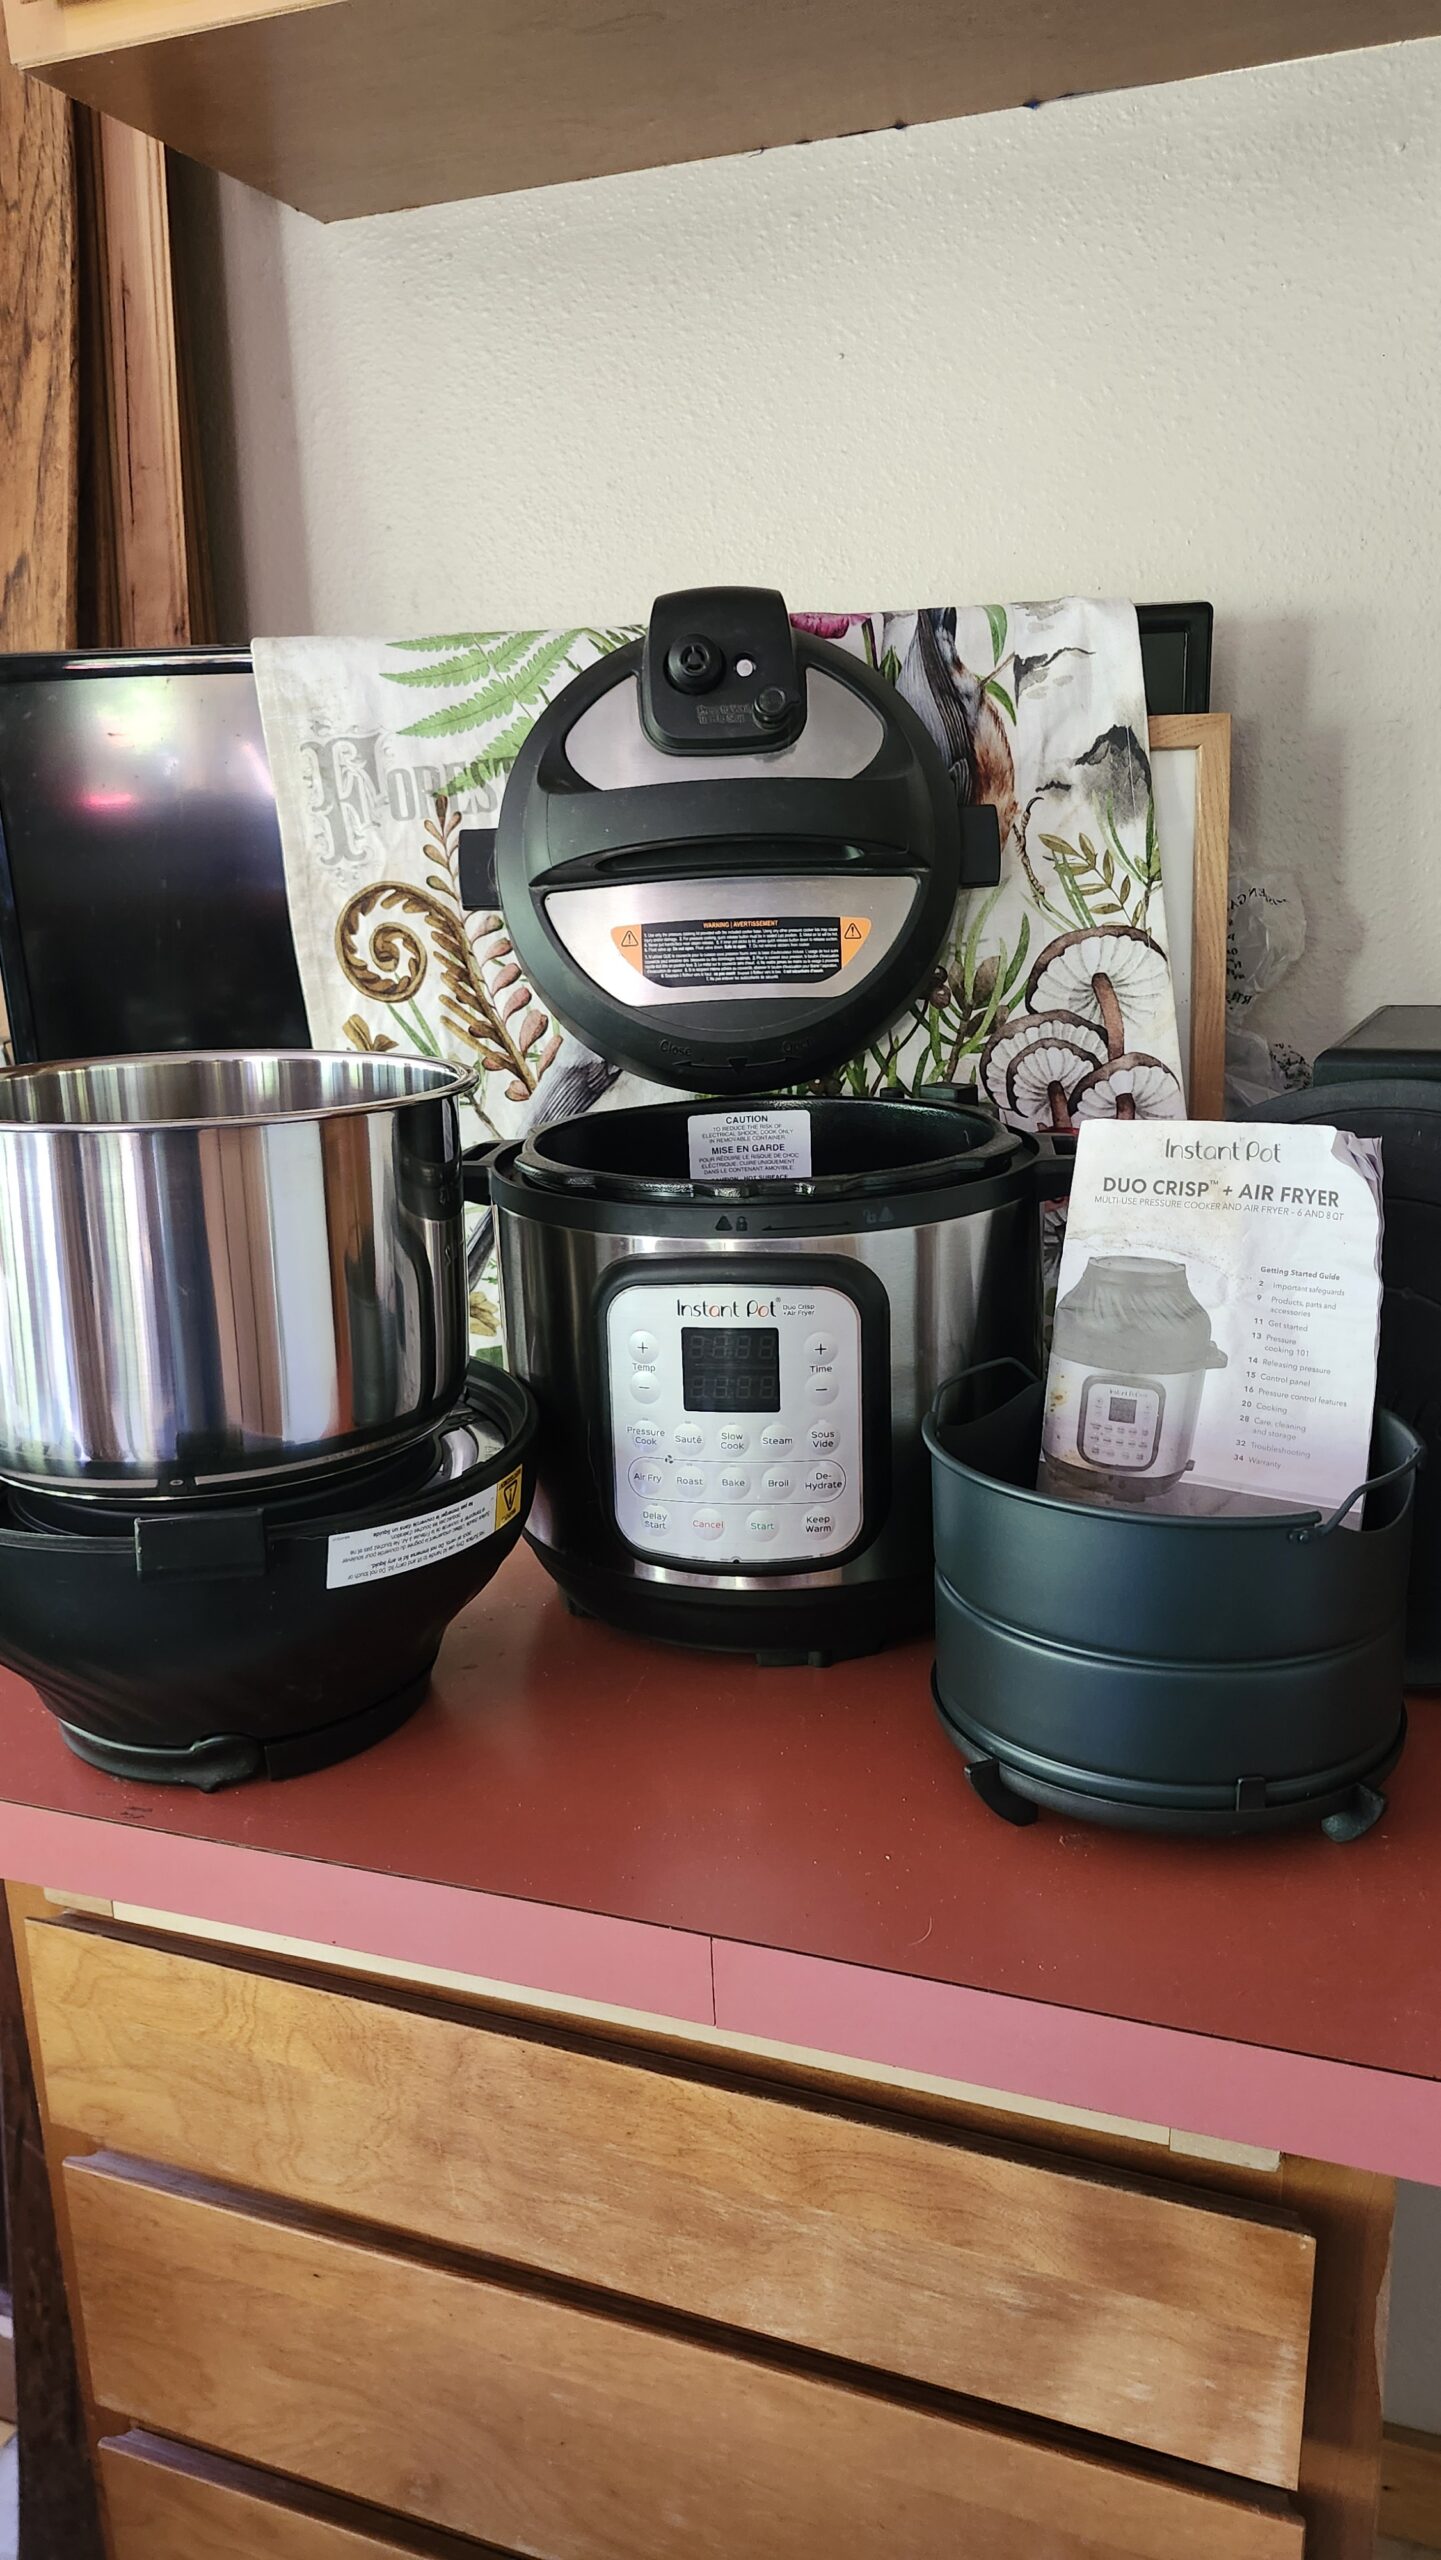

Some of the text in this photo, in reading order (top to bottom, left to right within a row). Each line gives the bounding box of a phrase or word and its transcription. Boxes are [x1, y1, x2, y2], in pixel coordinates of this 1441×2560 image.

[733, 920, 778, 928] AVERTISSEMENT
[658, 1038, 692, 1056] Close
[726, 1116, 768, 1124] CAUTION
[712, 1146, 733, 1154] MISE
[752, 1144, 785, 1152] GARDE
[1165, 1138, 1281, 1163] Instant Pot
[1103, 1177, 1147, 1193] DUO
[1223, 1186, 1232, 1195] +
[1239, 1184, 1274, 1201] AIR
[1280, 1187, 1339, 1207] FRYER
[1140, 1199, 1181, 1208] PRESSURE
[1184, 1201, 1221, 1210] COOKER
[1222, 1203, 1241, 1211] AND
[1261, 1206, 1289, 1215] FRYER
[1305, 1210, 1324, 1218] AND
[1332, 1213, 1344, 1221] QT
[1260, 1267, 1289, 1276] Getting
[1290, 1270, 1317, 1278] Started
[1273, 1283, 1307, 1291] Important
[1309, 1286, 1344, 1296] safeguards
[1271, 1296, 1304, 1306] Products,
[1305, 1301, 1321, 1309] parts
[677, 1299, 740, 1317] Instant
[1271, 1308, 1310, 1317] accessories
[1283, 1323, 1308, 1332] started
[1266, 1334, 1296, 1344] Pressure
[1265, 1345, 1294, 1356] cooking
[632, 1362, 656, 1373] Temp
[810, 1365, 832, 1373] Time
[1262, 1359, 1298, 1371] Releasing
[1300, 1366, 1331, 1374] pressure
[1260, 1373, 1287, 1383] Control
[1258, 1388, 1288, 1398] Pressure
[1291, 1393, 1316, 1403] control
[1318, 1397, 1347, 1407] features
[1256, 1402, 1287, 1414] Cooking
[627, 1427, 665, 1436] Pressure
[1275, 1421, 1306, 1433] cleaning
[721, 1432, 743, 1440] Slow
[1268, 1431, 1296, 1440] storage
[635, 1437, 656, 1445] Cook
[763, 1437, 792, 1445] Steam
[1251, 1442, 1311, 1459] Troubleshooting
[1249, 1457, 1281, 1469] Warranty
[648, 1475, 661, 1483] Fry
[677, 1477, 703, 1485] Roast
[805, 1481, 842, 1491] Hydrate
[643, 1512, 667, 1520] Delay
[644, 1521, 666, 1529] Start
[693, 1520, 723, 1528] Cancel
[354, 1570, 369, 1579] touch
